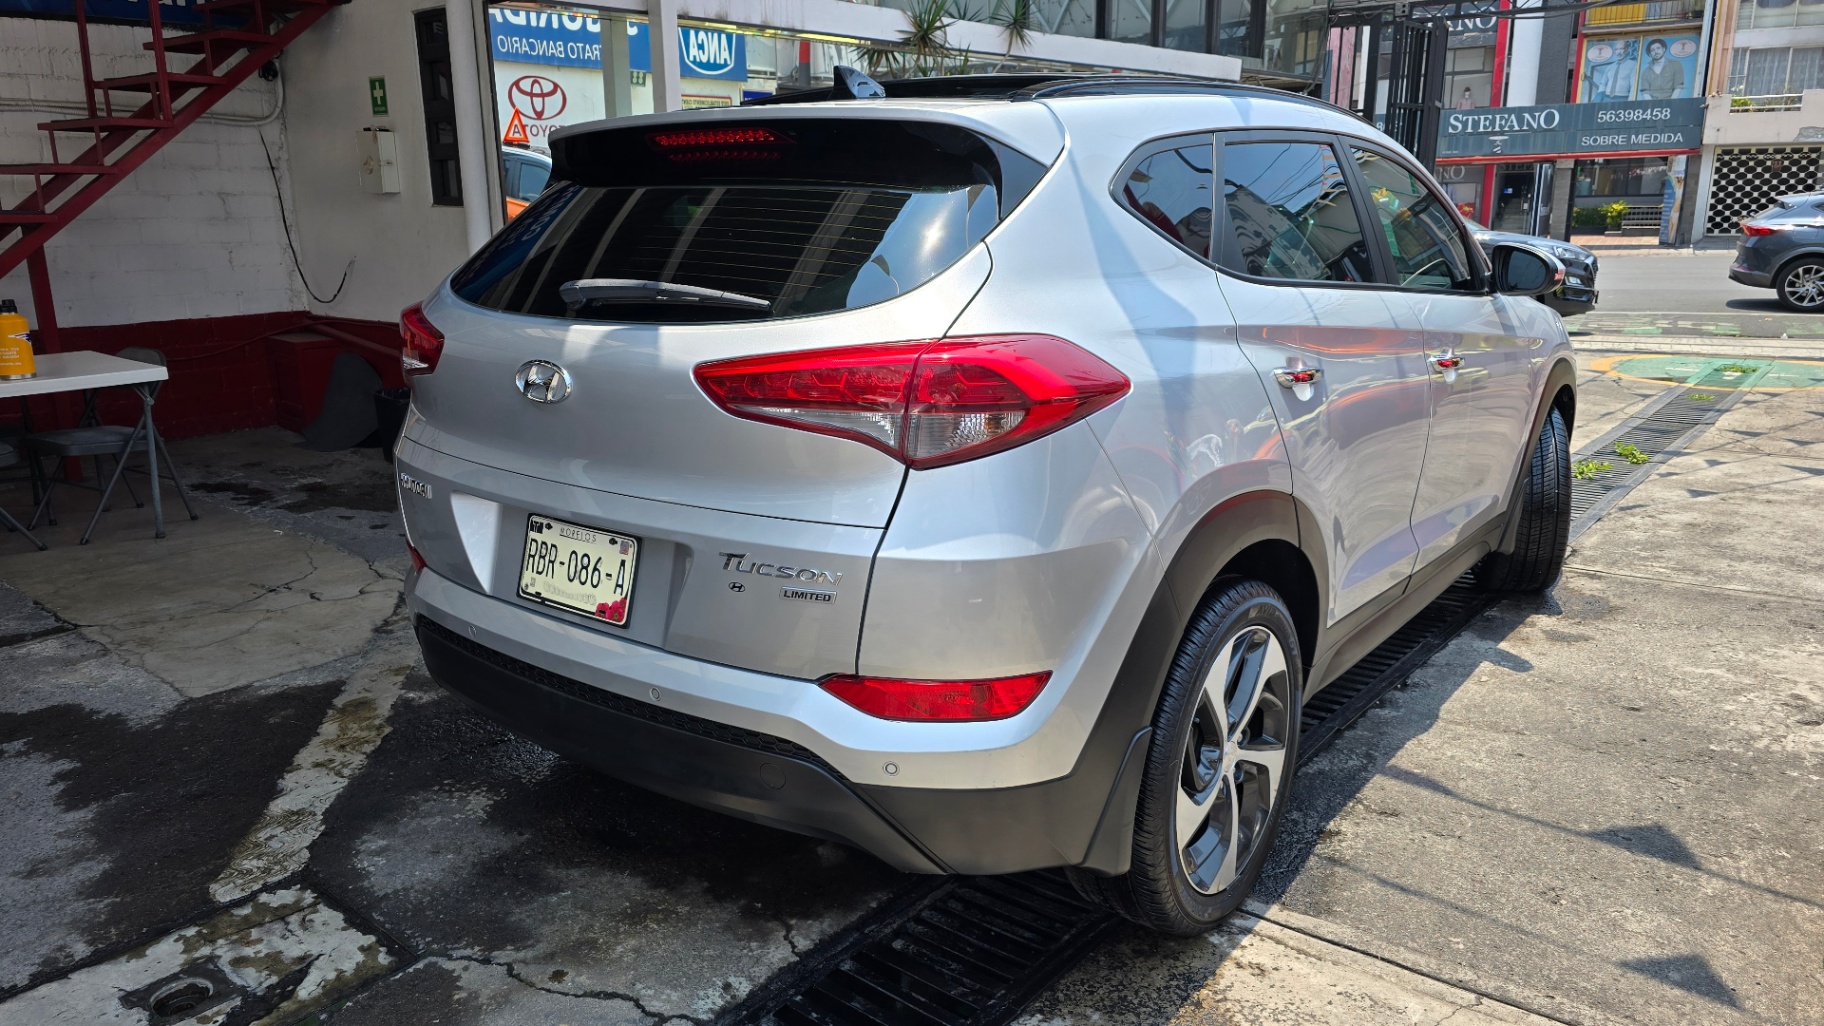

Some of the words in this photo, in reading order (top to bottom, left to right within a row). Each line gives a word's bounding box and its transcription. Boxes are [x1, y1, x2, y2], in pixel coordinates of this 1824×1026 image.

[1448, 108, 1560, 134] STEFANO
[1597, 107, 1671, 124] 56398458
[1581, 134, 1628, 147] SOBRE
[1630, 132, 1684, 145] MEDIDA
[525, 537, 627, 597] RBR-086-A
[719, 551, 844, 586] TUCSON
[783, 590, 831, 602] LIMITED
